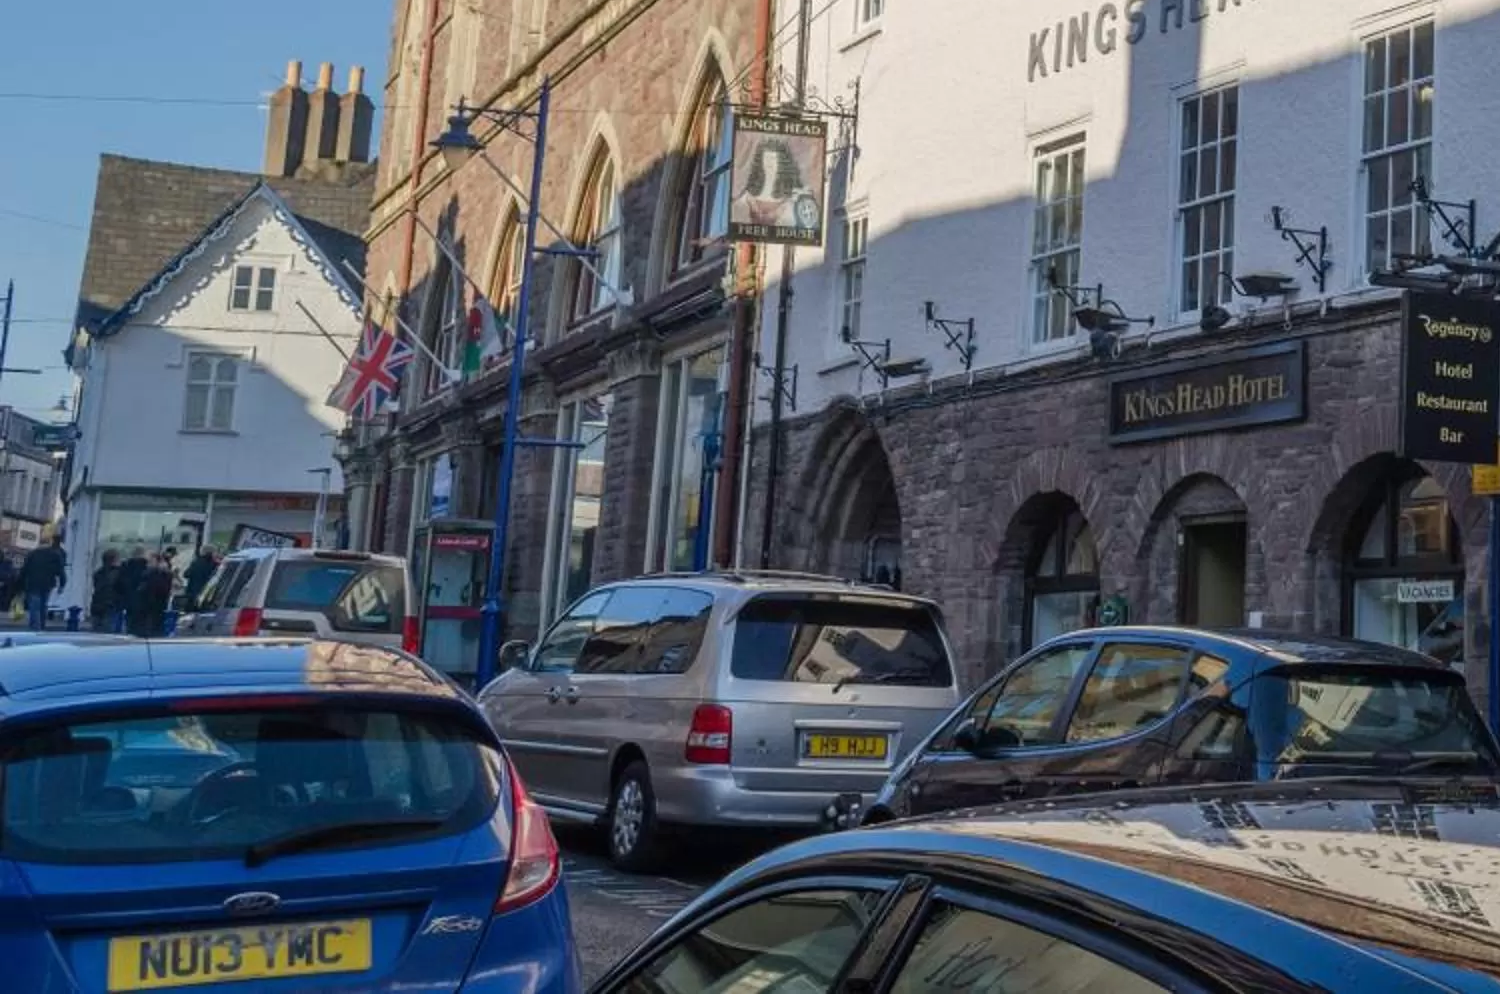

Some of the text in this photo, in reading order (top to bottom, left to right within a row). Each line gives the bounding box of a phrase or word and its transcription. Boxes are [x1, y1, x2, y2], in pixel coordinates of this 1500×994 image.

[784, 121, 822, 136] HEAD
[1417, 313, 1479, 343] Regency
[1434, 361, 1474, 381] Hotel
[1416, 390, 1489, 415] Restaurant
[1439, 427, 1465, 444] Bar
[138, 926, 343, 981] NU13 YMC
